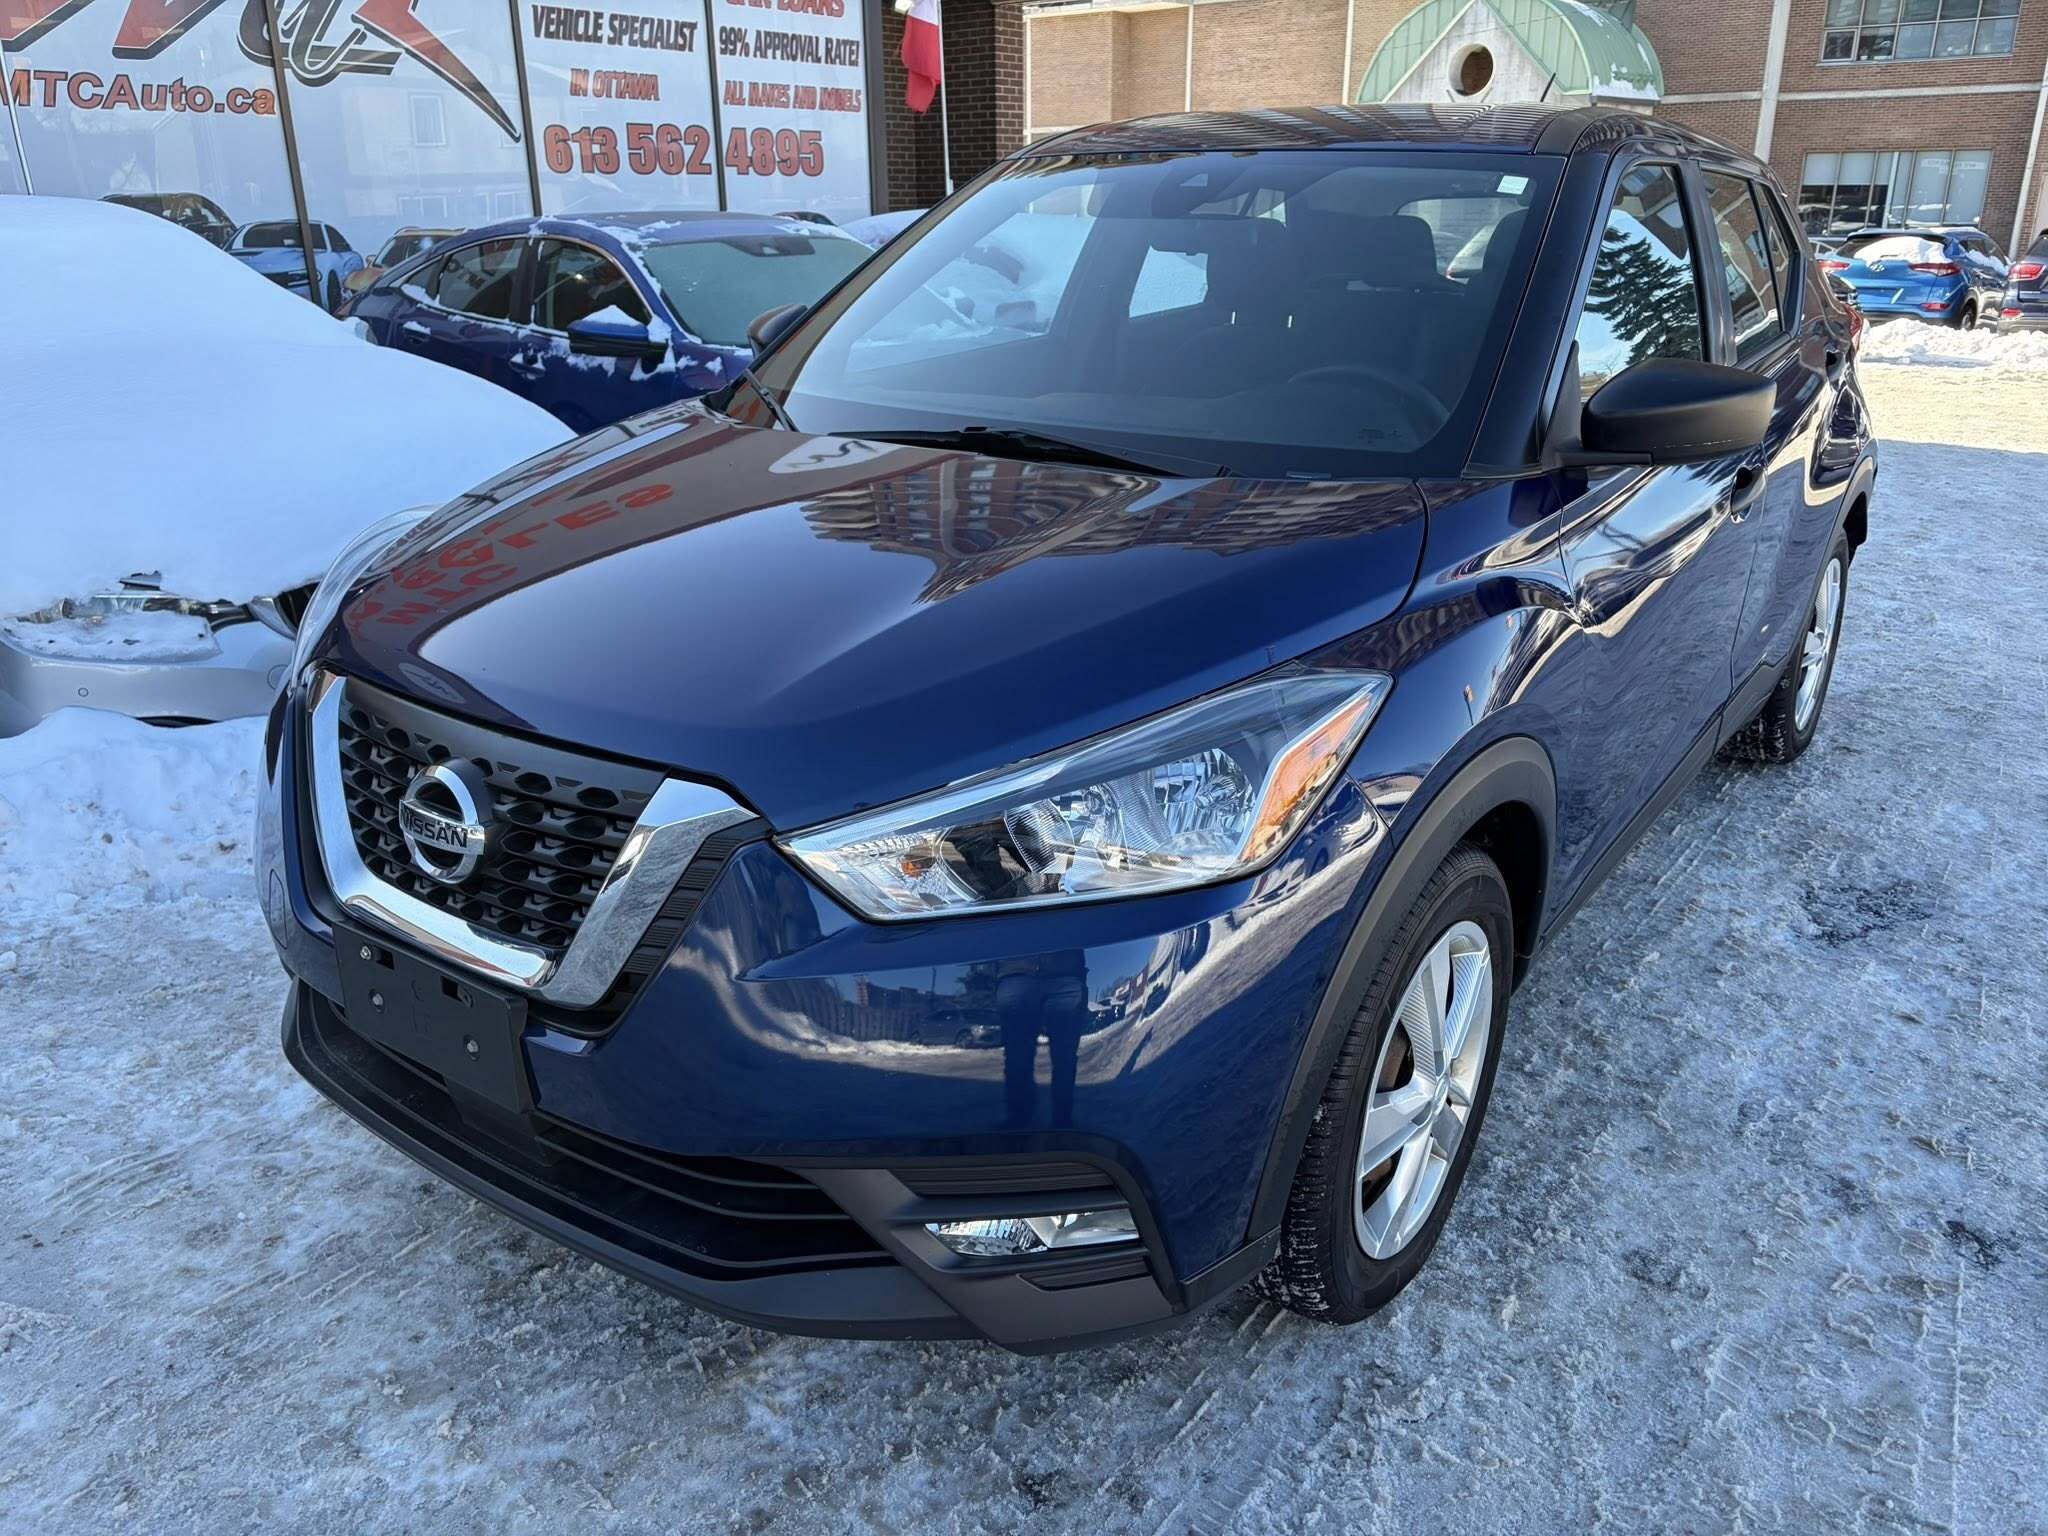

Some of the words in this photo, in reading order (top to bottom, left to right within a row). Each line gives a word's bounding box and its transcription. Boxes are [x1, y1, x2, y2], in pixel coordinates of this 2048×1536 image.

[531, 4, 604, 44] VEHICLE
[607, 13, 698, 52] SPECIALIST
[719, 25, 750, 58] 99%
[753, 29, 822, 64] APPROVAL
[824, 36, 860, 67] RATE!
[0, 68, 277, 115] MTCAuto.ca
[570, 68, 589, 97] IN
[592, 70, 660, 101] OTTAWA
[723, 80, 746, 106] ALL
[748, 82, 790, 109] MAKES
[792, 85, 817, 110] AND
[819, 86, 862, 113] MODELS
[543, 124, 621, 174] 613
[626, 122, 712, 175] 562
[725, 127, 825, 177] 4895
[401, 801, 468, 848] NISSAN
